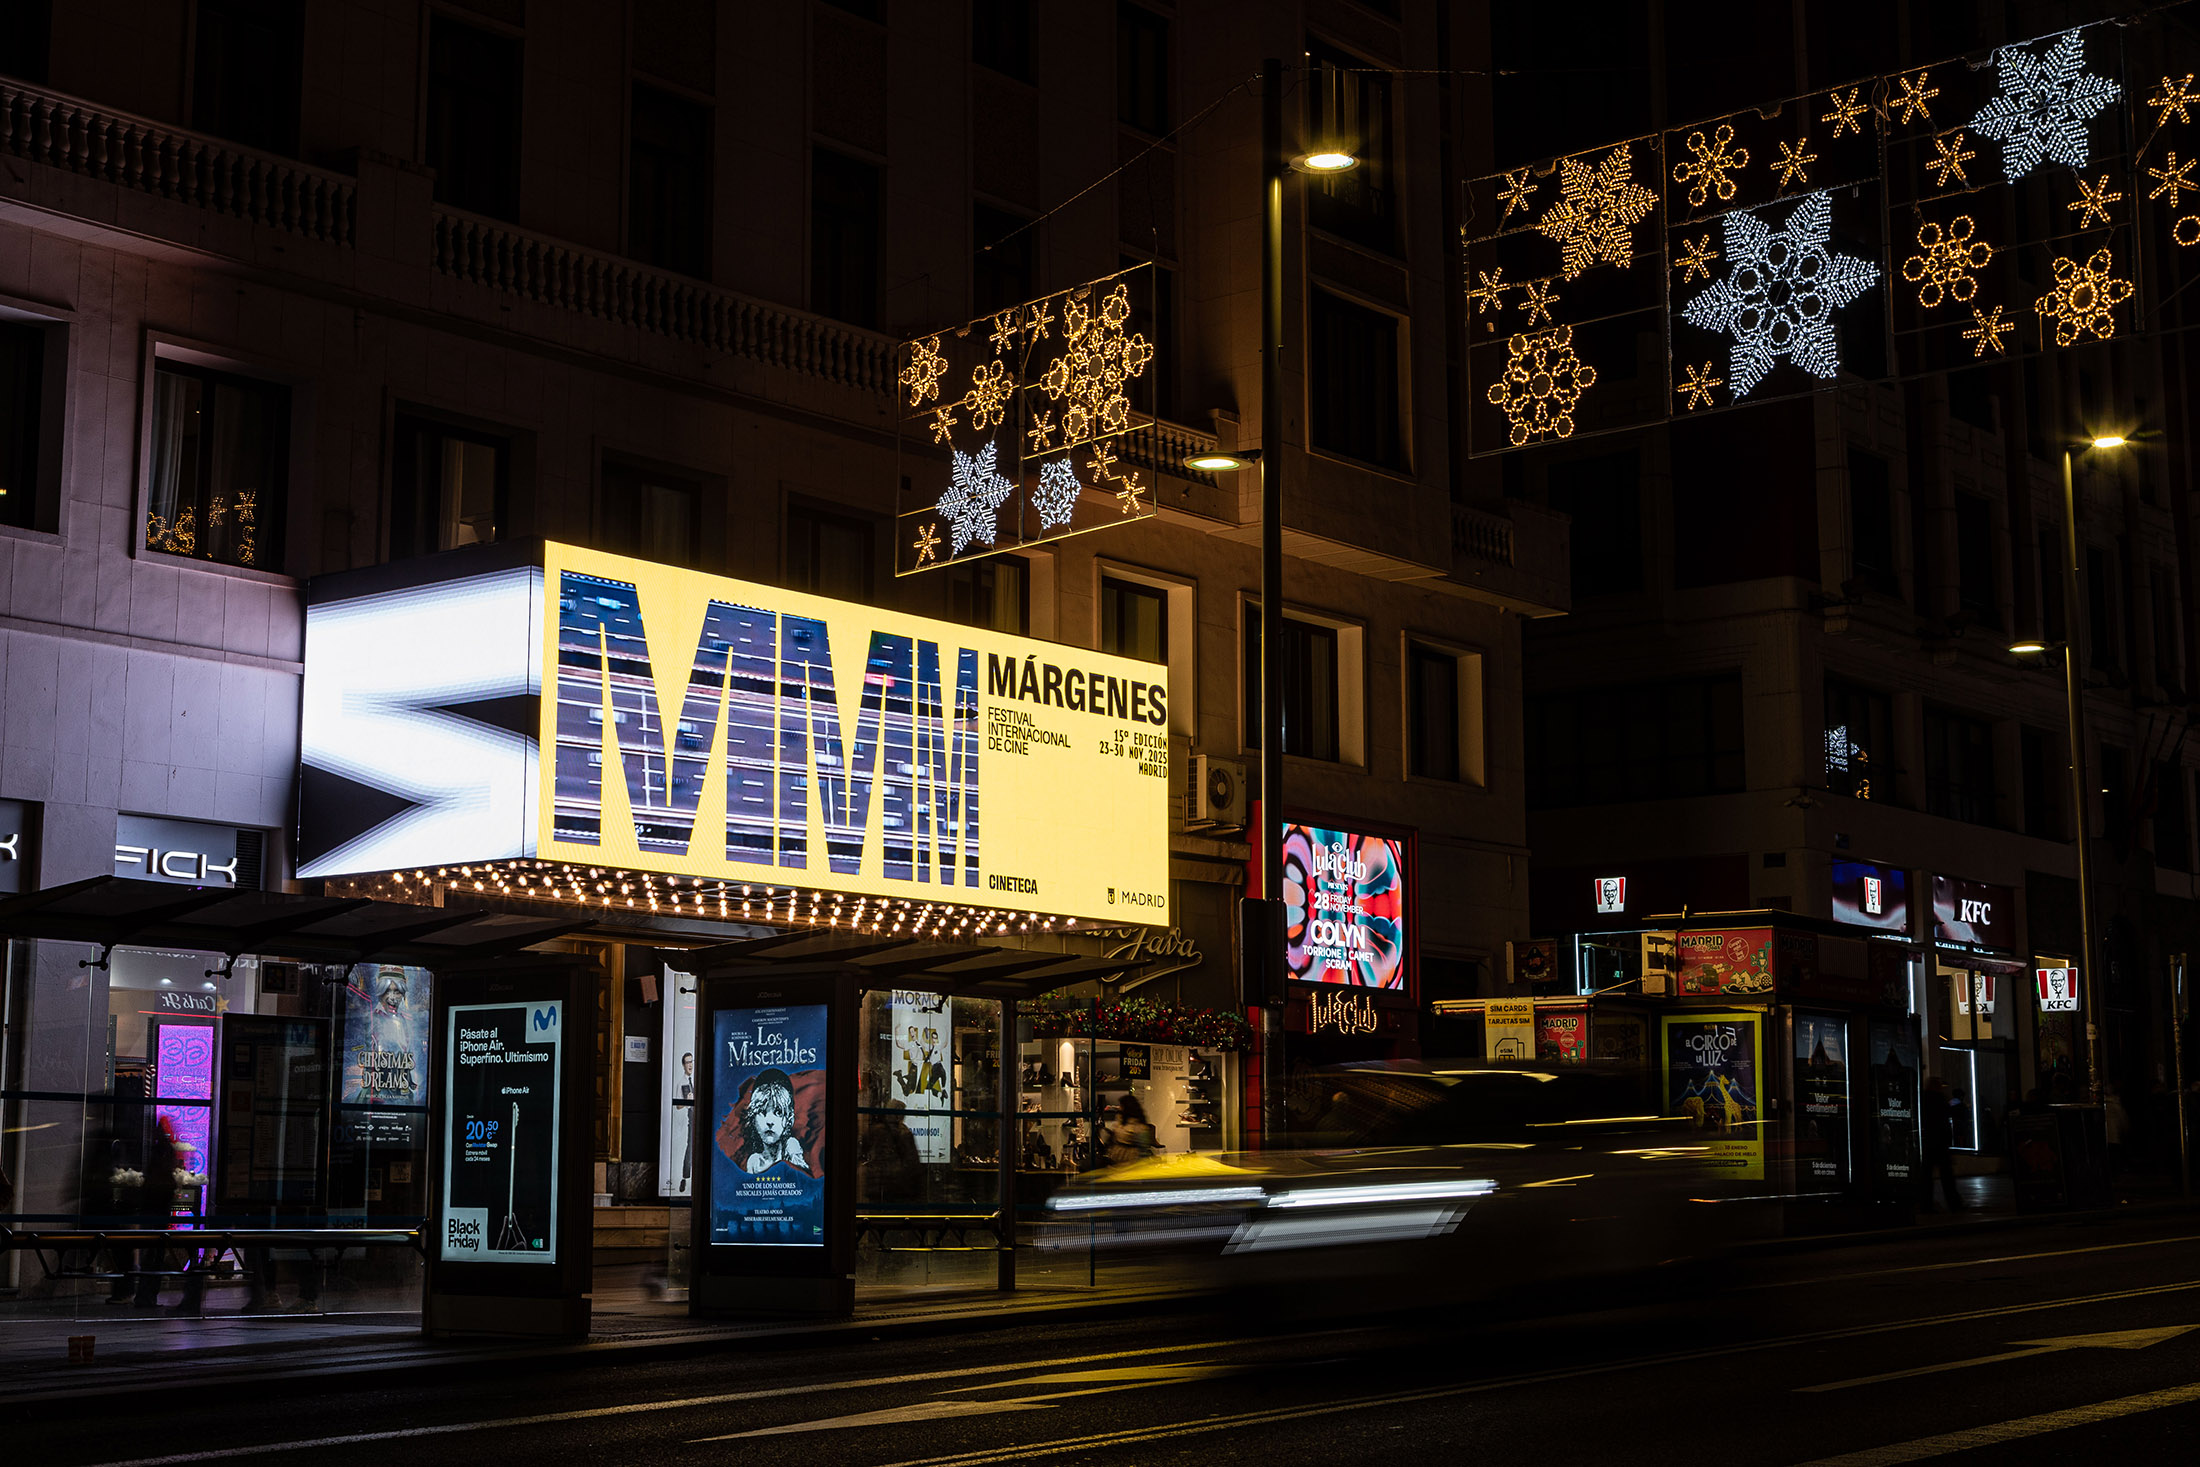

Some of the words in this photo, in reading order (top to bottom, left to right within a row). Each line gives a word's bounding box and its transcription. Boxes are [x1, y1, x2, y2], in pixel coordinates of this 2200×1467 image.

[987, 653, 1167, 726] MÁRGENES
[988, 707, 1036, 727] FESTIVAL
[988, 722, 1072, 748] INTERNACIONAL
[1134, 732, 1167, 750] EDICIÓN
[1003, 739, 1029, 756] CINE
[1099, 740, 1124, 757] 23-30
[1129, 745, 1167, 764] NOV.2025
[1138, 762, 1167, 778] MADRID
[115, 844, 238, 883] FICK
[989, 874, 1038, 895] CINETECA
[1121, 891, 1166, 908] MADRID
[1313, 892, 1330, 910] 28
[1330, 894, 1352, 905] FRIDAY
[1330, 903, 1364, 915] NOVEMBER
[1960, 899, 1991, 925] KFC
[1310, 919, 1366, 949] COLYN
[1681, 935, 1724, 948] MADRID
[1302, 945, 1342, 959] TORRIONE
[1325, 959, 1352, 970] SCRAM
[894, 990, 949, 1008] MORMO
[2047, 1000, 2072, 1009] KFC
[1503, 1004, 1528, 1012] CARDS
[1541, 1018, 1578, 1029] MADRID
[460, 1028, 489, 1040] Pásate
[490, 1027, 498, 1039] al
[757, 1026, 782, 1046] Los
[460, 1041, 488, 1052] iPhone
[489, 1040, 505, 1051] Air.
[1691, 1033, 1731, 1052] CIRCO
[460, 1053, 504, 1067] Superfino.
[505, 1051, 549, 1063] Ultimísimo
[728, 1037, 816, 1067] Miserables
[1702, 1050, 1722, 1067] LUZ
[357, 1051, 415, 1071] CHRISTMAS
[1123, 1057, 1148, 1067] FRIDAY
[361, 1071, 410, 1092] DREAMS
[506, 1086, 522, 1095] iPhone
[1815, 1093, 1829, 1104] Valor
[1887, 1097, 1902, 1108] Valor
[762, 1189, 778, 1197] JAMÁS
[448, 1219, 480, 1234] Black
[448, 1235, 480, 1252] Friday
